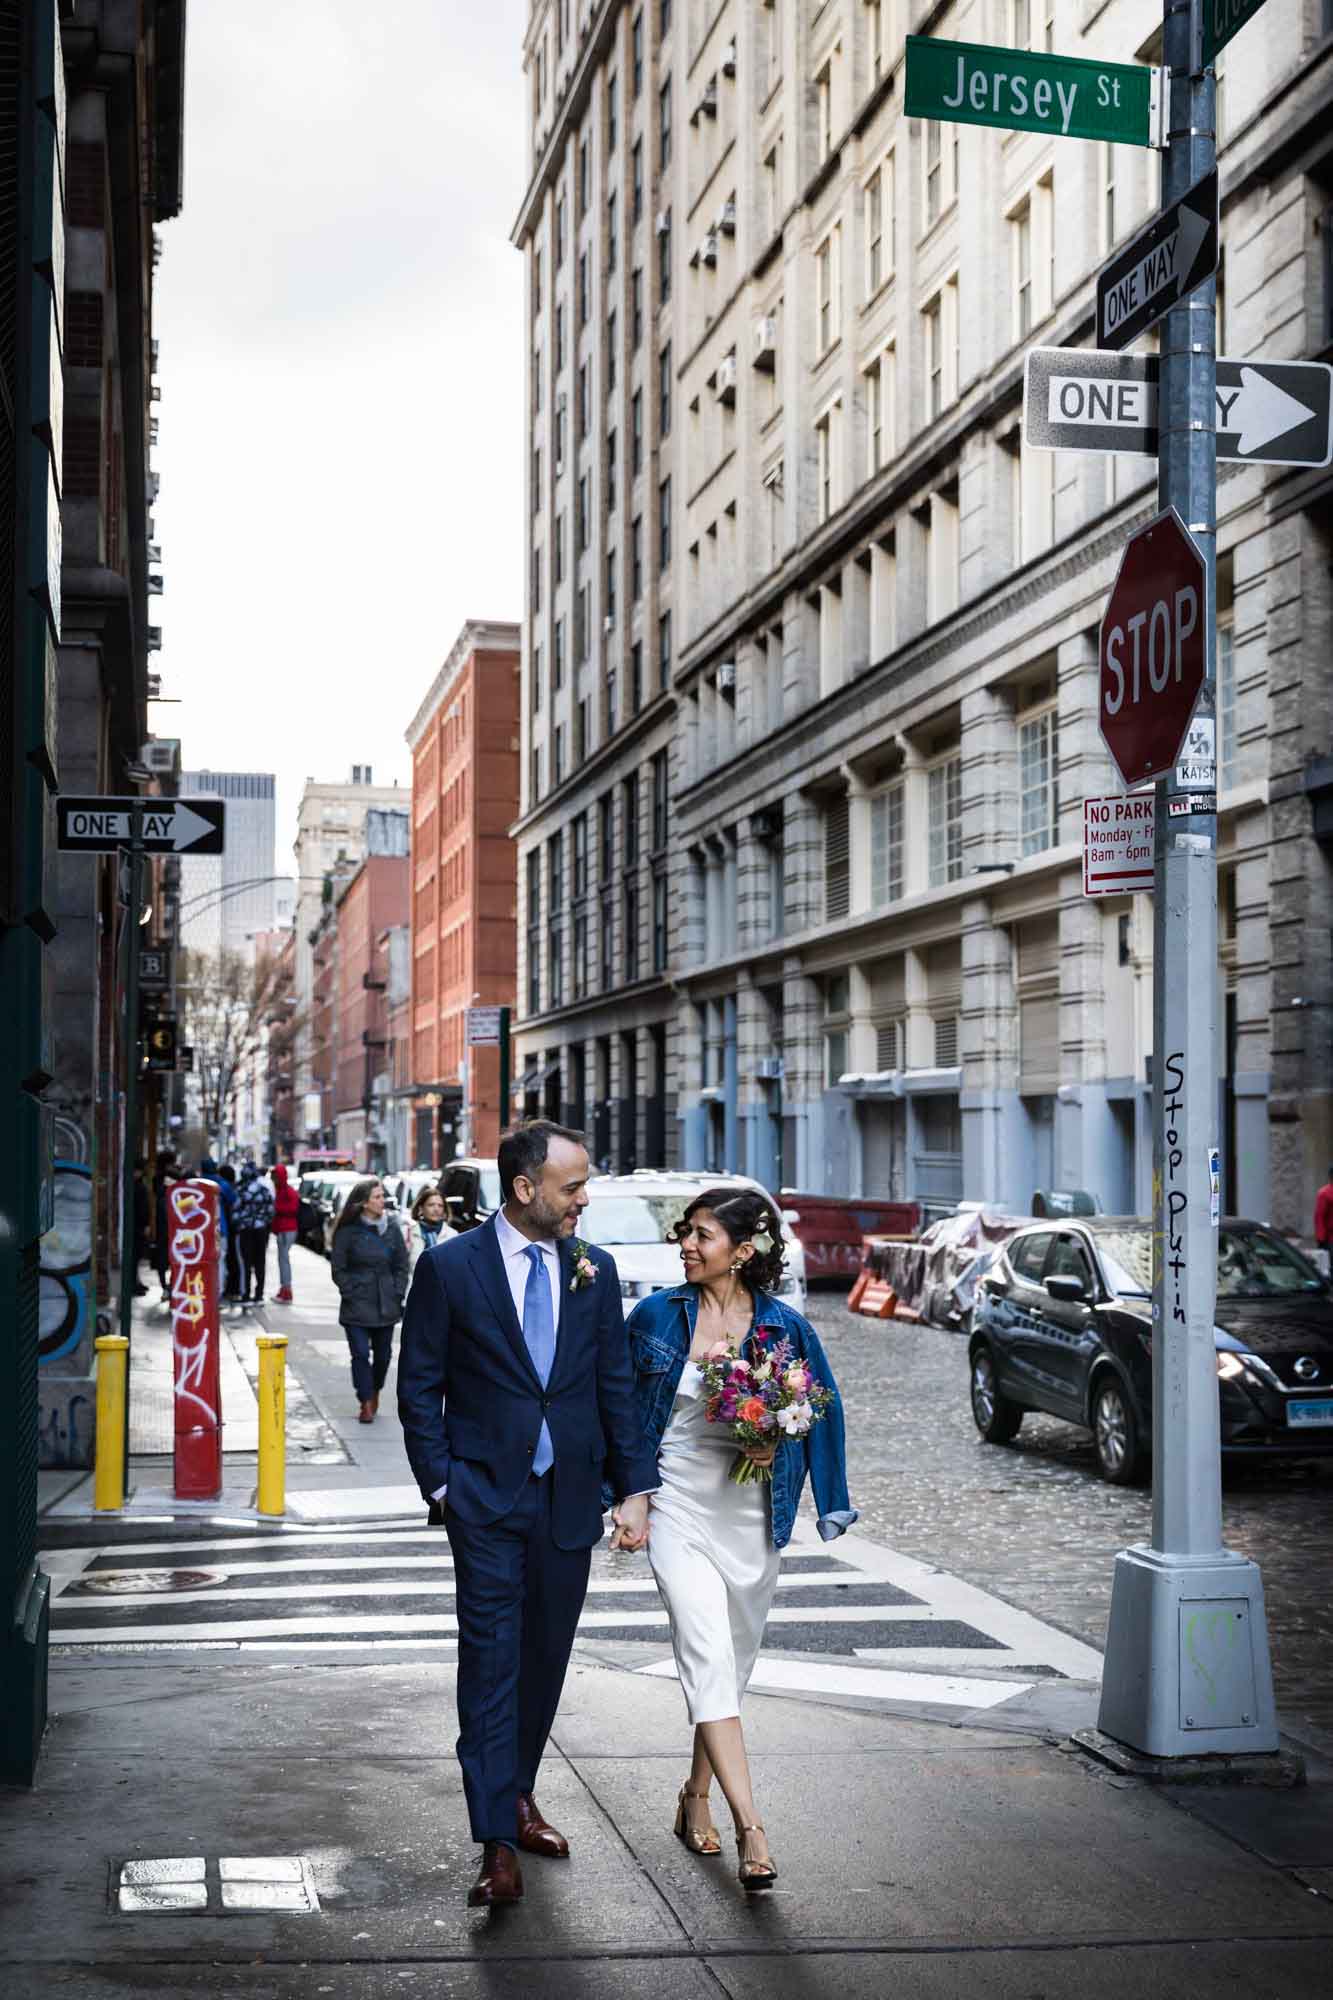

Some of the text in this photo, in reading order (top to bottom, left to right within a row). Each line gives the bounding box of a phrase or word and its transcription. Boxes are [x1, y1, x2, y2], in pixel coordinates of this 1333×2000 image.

[943, 56, 1121, 134] Jersey St
[1108, 233, 1178, 327] ONE WAY
[1060, 382, 1140, 422] ONE
[1105, 585, 1198, 715] STOP
[73, 815, 118, 835] ONE
[1090, 806, 1110, 824] NO
[1115, 801, 1153, 820] PARK
[1090, 827, 1133, 844] Monday
[1145, 825, 1154, 839] Fr
[1091, 848, 1115, 863] 8am
[1126, 844, 1150, 861] 6pm
[1163, 1053, 1184, 1180] Stop
